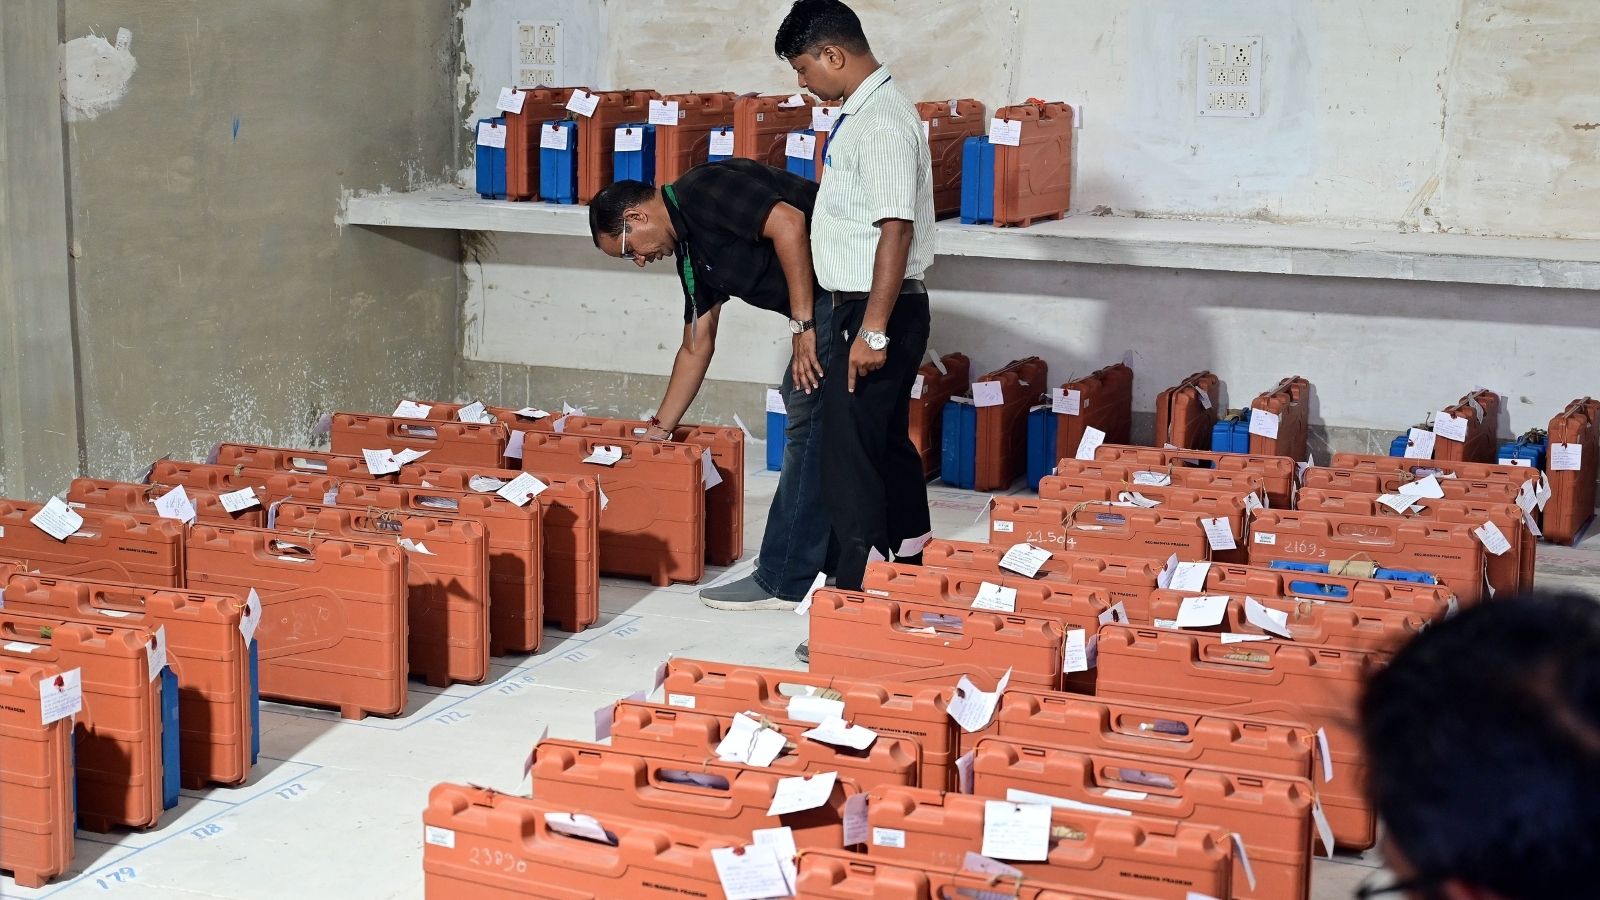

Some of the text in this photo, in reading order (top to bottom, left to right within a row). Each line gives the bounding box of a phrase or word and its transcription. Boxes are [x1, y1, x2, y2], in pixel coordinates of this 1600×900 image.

[4, 705, 26, 713] PRADESH
[190, 823, 224, 840] 178
[95, 865, 137, 890] 179
